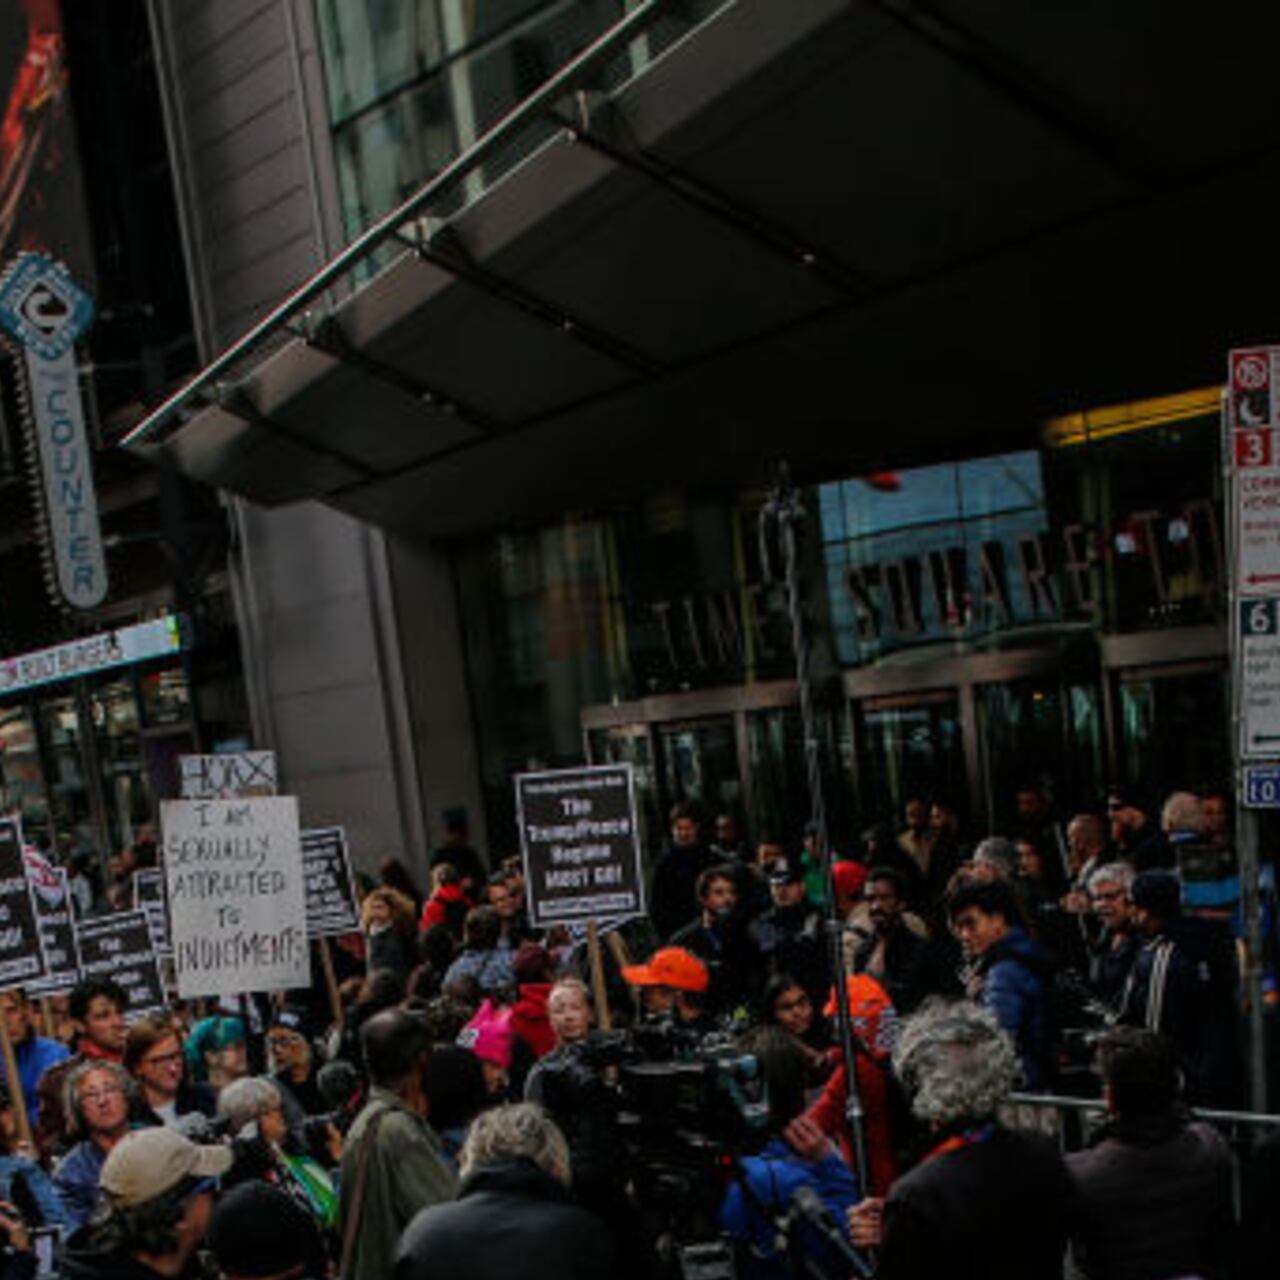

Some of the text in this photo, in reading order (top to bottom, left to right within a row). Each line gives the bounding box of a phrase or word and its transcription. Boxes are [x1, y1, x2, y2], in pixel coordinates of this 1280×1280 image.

[1244, 433, 1264, 464] 3
[46, 388, 94, 595] COUNTER
[845, 522, 1098, 641] SQUARE
[653, 592, 790, 672] TIME
[1248, 603, 1270, 633] 6
[194, 804, 215, 828] I
